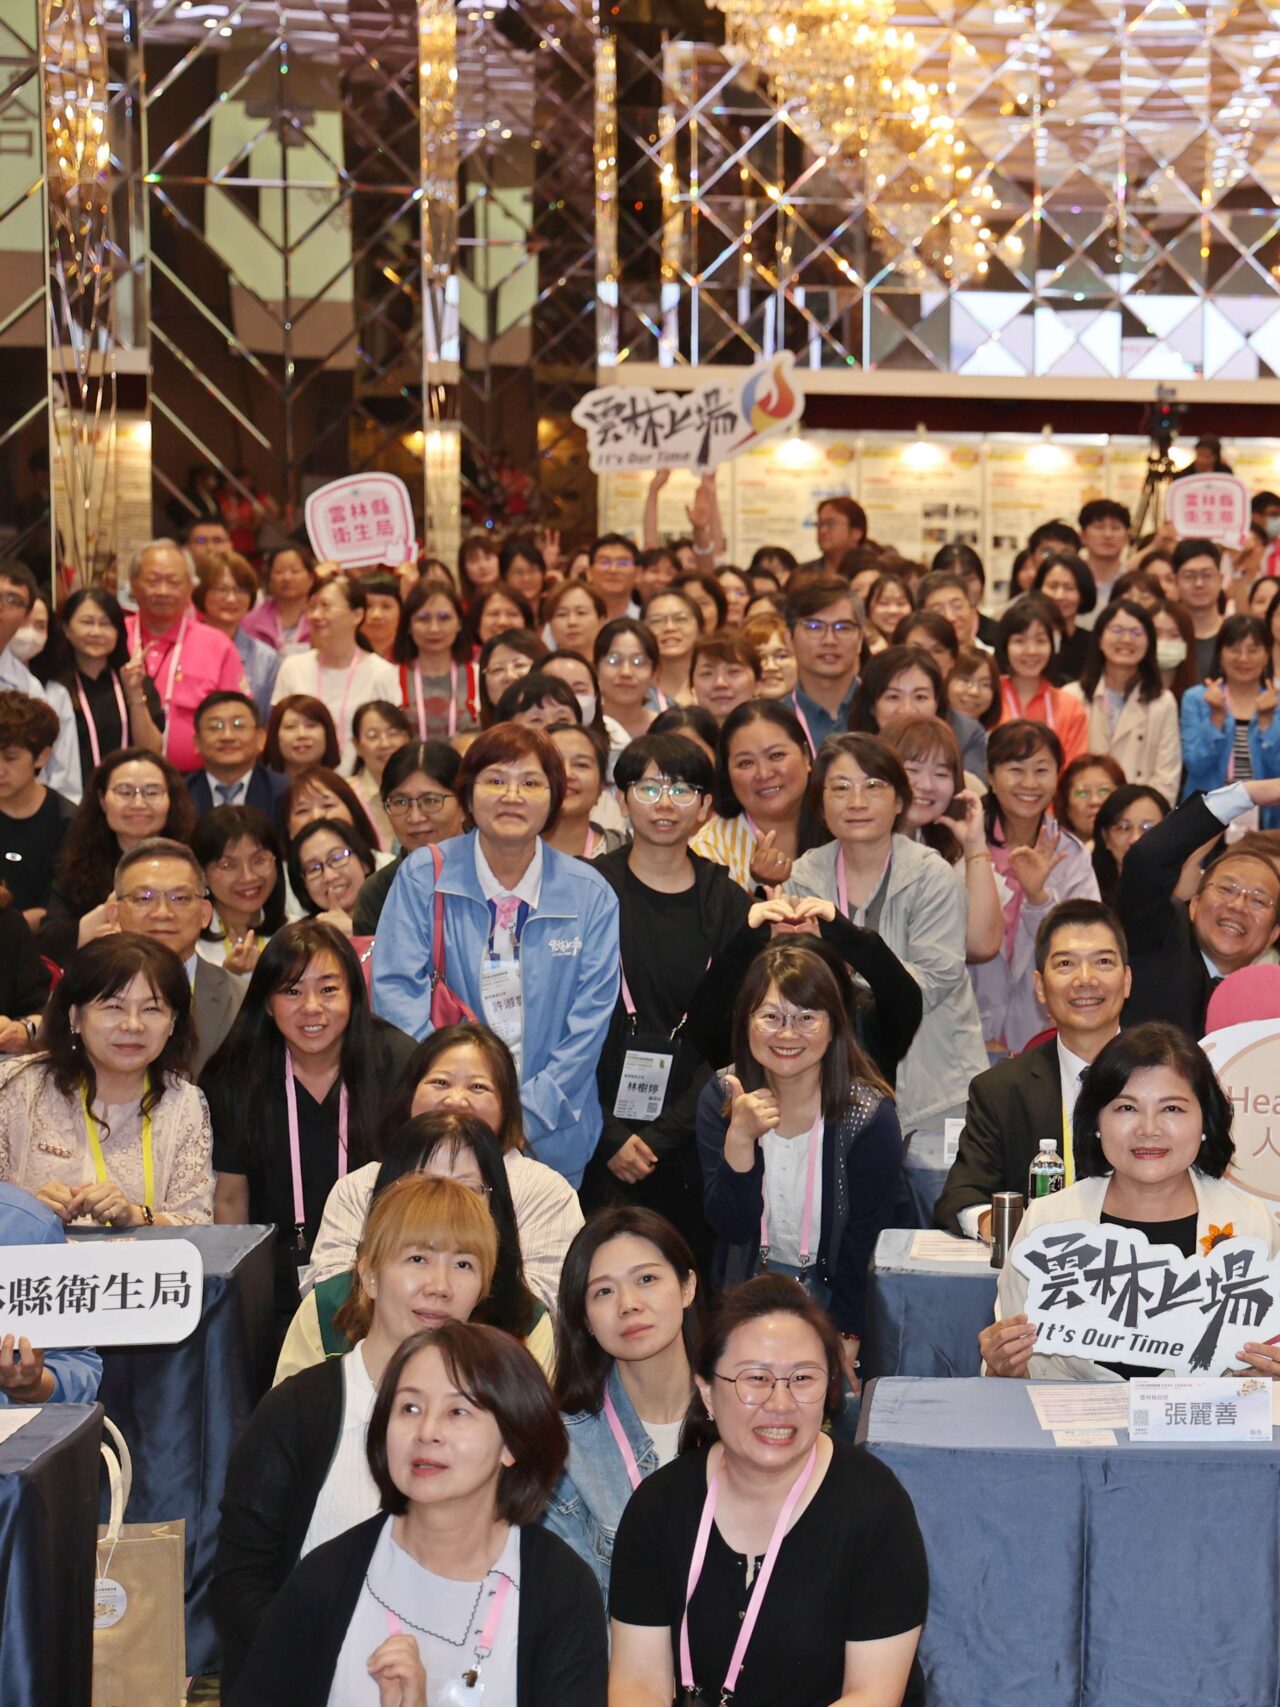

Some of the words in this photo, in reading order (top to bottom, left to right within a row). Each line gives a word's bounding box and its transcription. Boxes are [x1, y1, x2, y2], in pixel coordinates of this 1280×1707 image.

[584, 387, 738, 465] 雲林上場
[599, 452, 623, 465] It's
[627, 452, 652, 464] Our
[657, 450, 691, 463] Time
[328, 497, 390, 525] 雲林縣
[332, 519, 394, 545] 衛生局
[0, 1270, 192, 1316] 縣衛生局
[1024, 1232, 1274, 1373] 雲林上場
[1082, 1327, 1125, 1349] Our
[1129, 1333, 1185, 1357] Time
[1164, 1402, 1238, 1426] 張麗善
